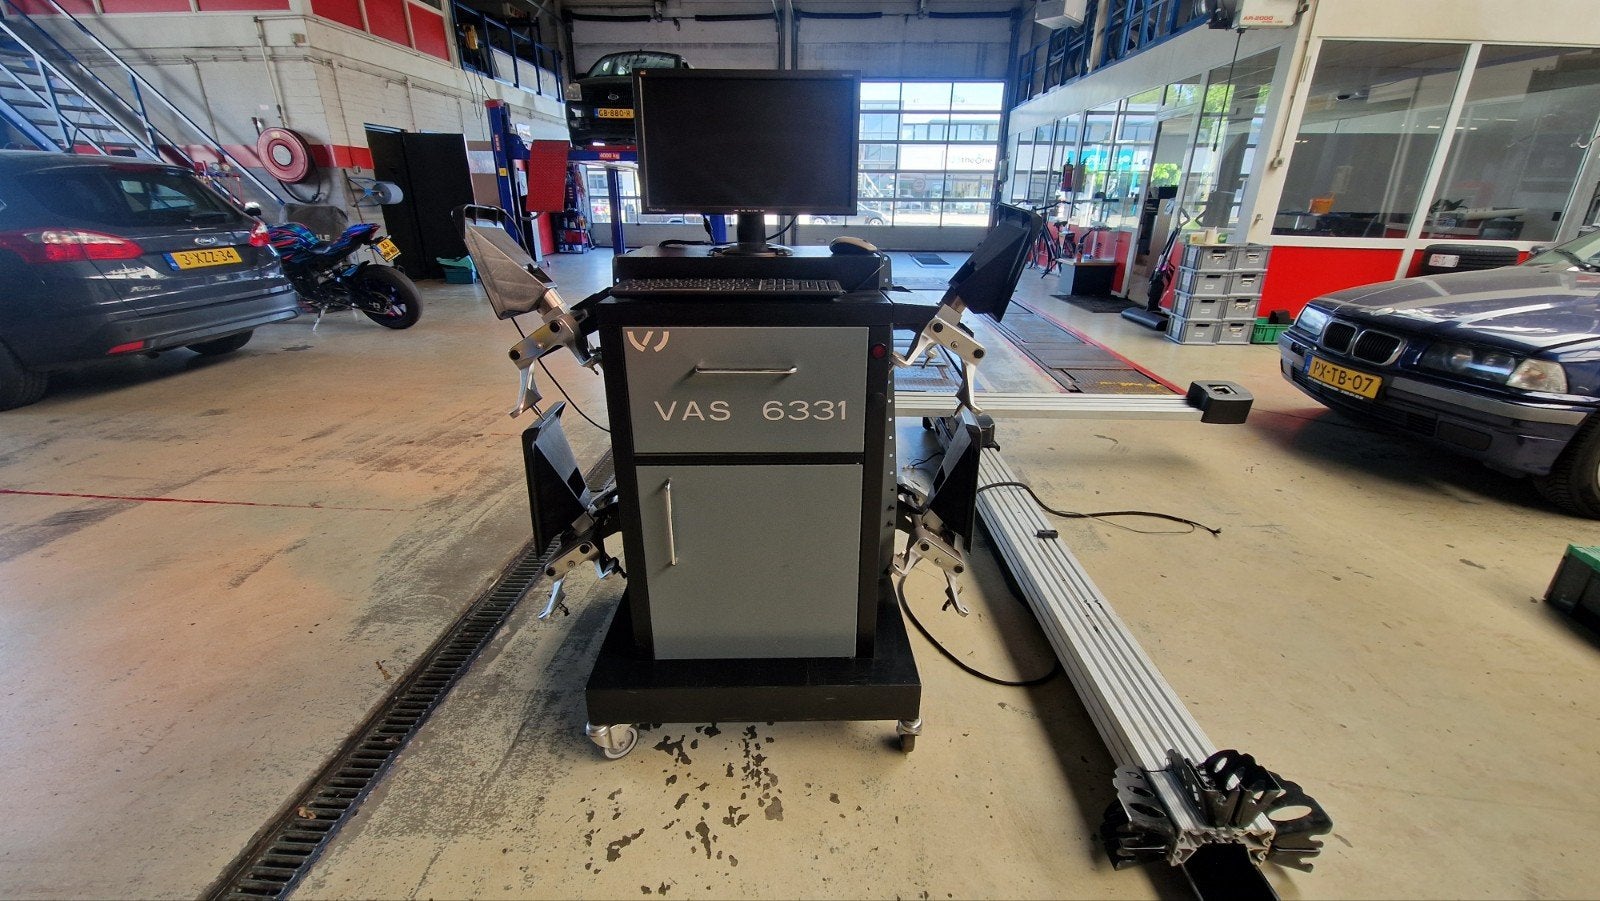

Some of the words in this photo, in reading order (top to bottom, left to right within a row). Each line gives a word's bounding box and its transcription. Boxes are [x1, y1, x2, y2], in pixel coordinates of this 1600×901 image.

[180, 250, 234, 266] 3-XZZ-34
[1313, 361, 1374, 393] PX-TB-07
[653, 400, 731, 421] VAS
[762, 400, 847, 421] 6331
